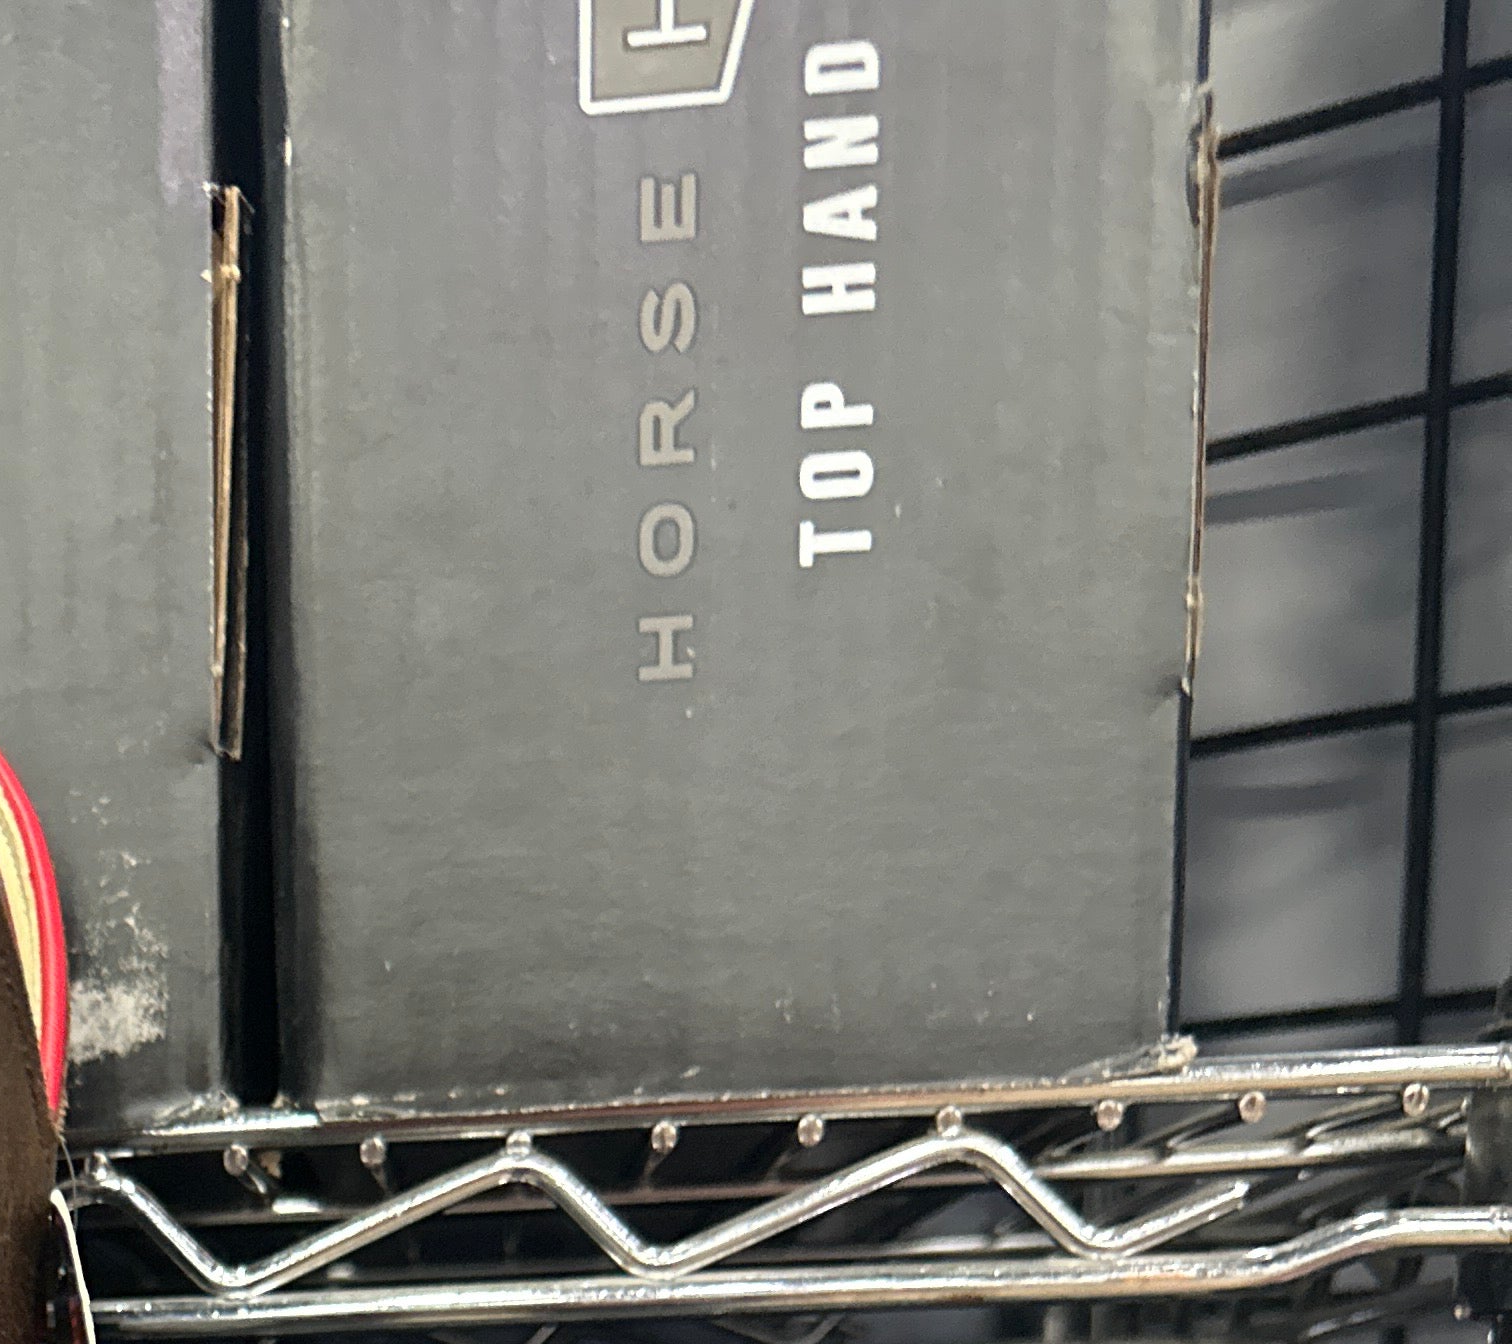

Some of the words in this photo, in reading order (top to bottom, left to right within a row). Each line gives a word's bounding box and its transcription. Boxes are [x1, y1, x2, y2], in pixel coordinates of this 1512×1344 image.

[801, 38, 880, 315] HAND
[637, 172, 698, 683] HORSE
[797, 379, 876, 568] TOP
